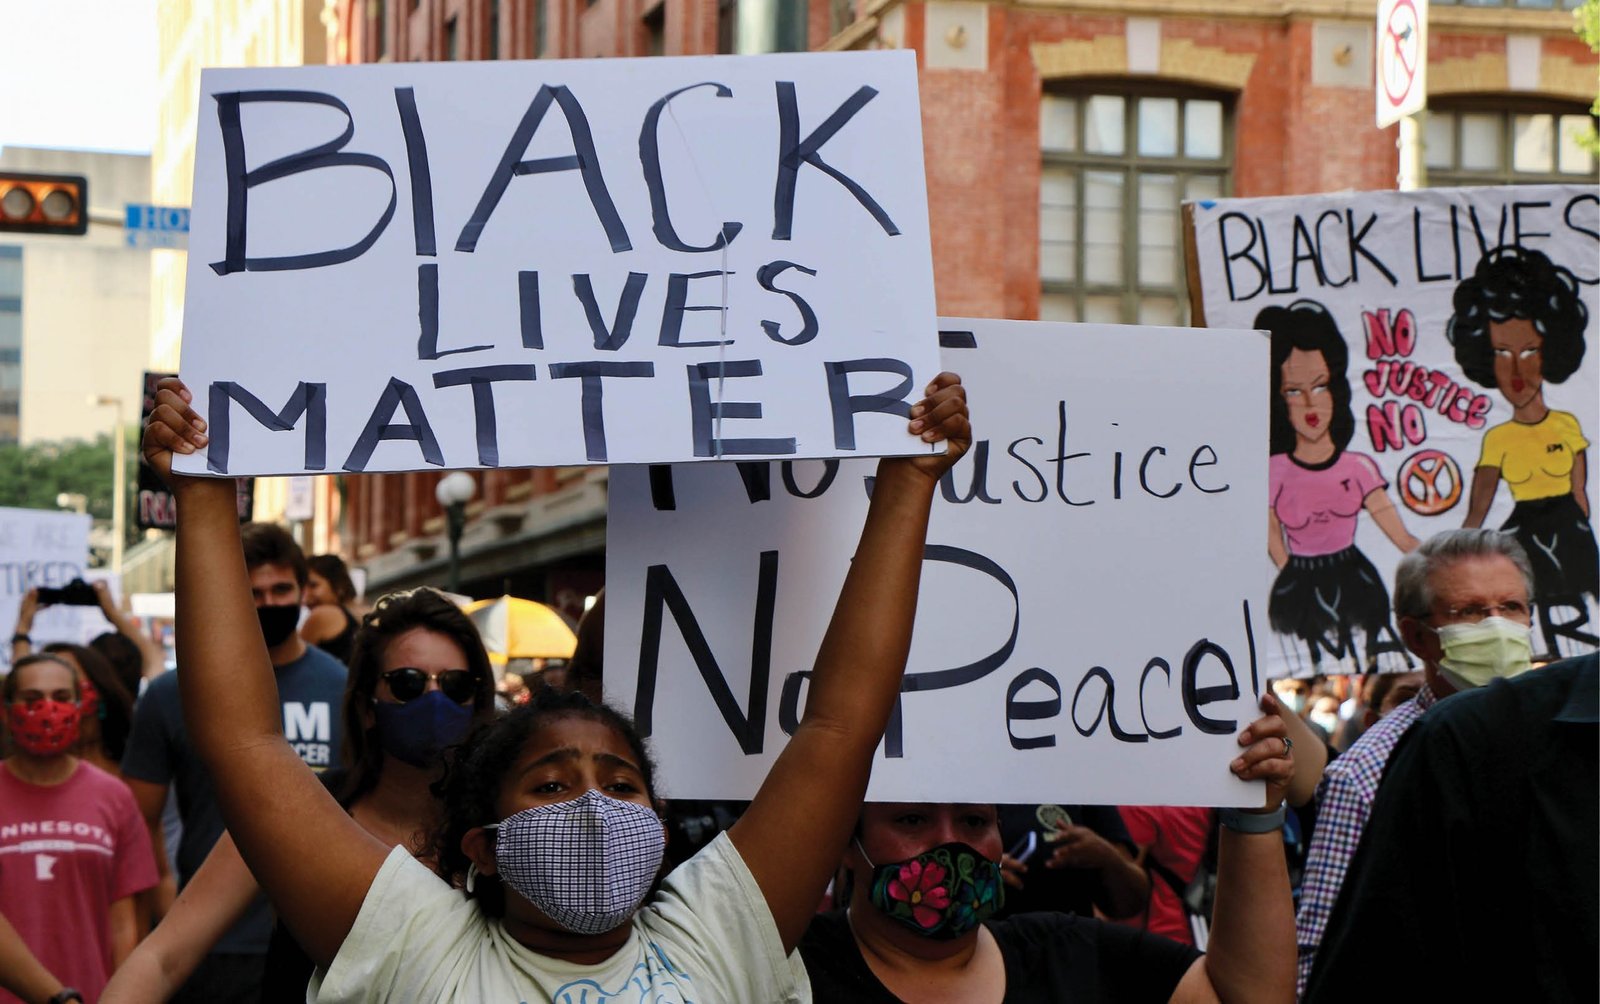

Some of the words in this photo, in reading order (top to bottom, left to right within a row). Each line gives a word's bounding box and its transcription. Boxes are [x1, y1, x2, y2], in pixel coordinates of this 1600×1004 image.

[209, 81, 902, 276] BLACK
[1219, 209, 1398, 301] BLACK
[417, 260, 818, 360] LIVES
[1362, 308, 1417, 360] NO
[1366, 400, 1427, 453] NO
